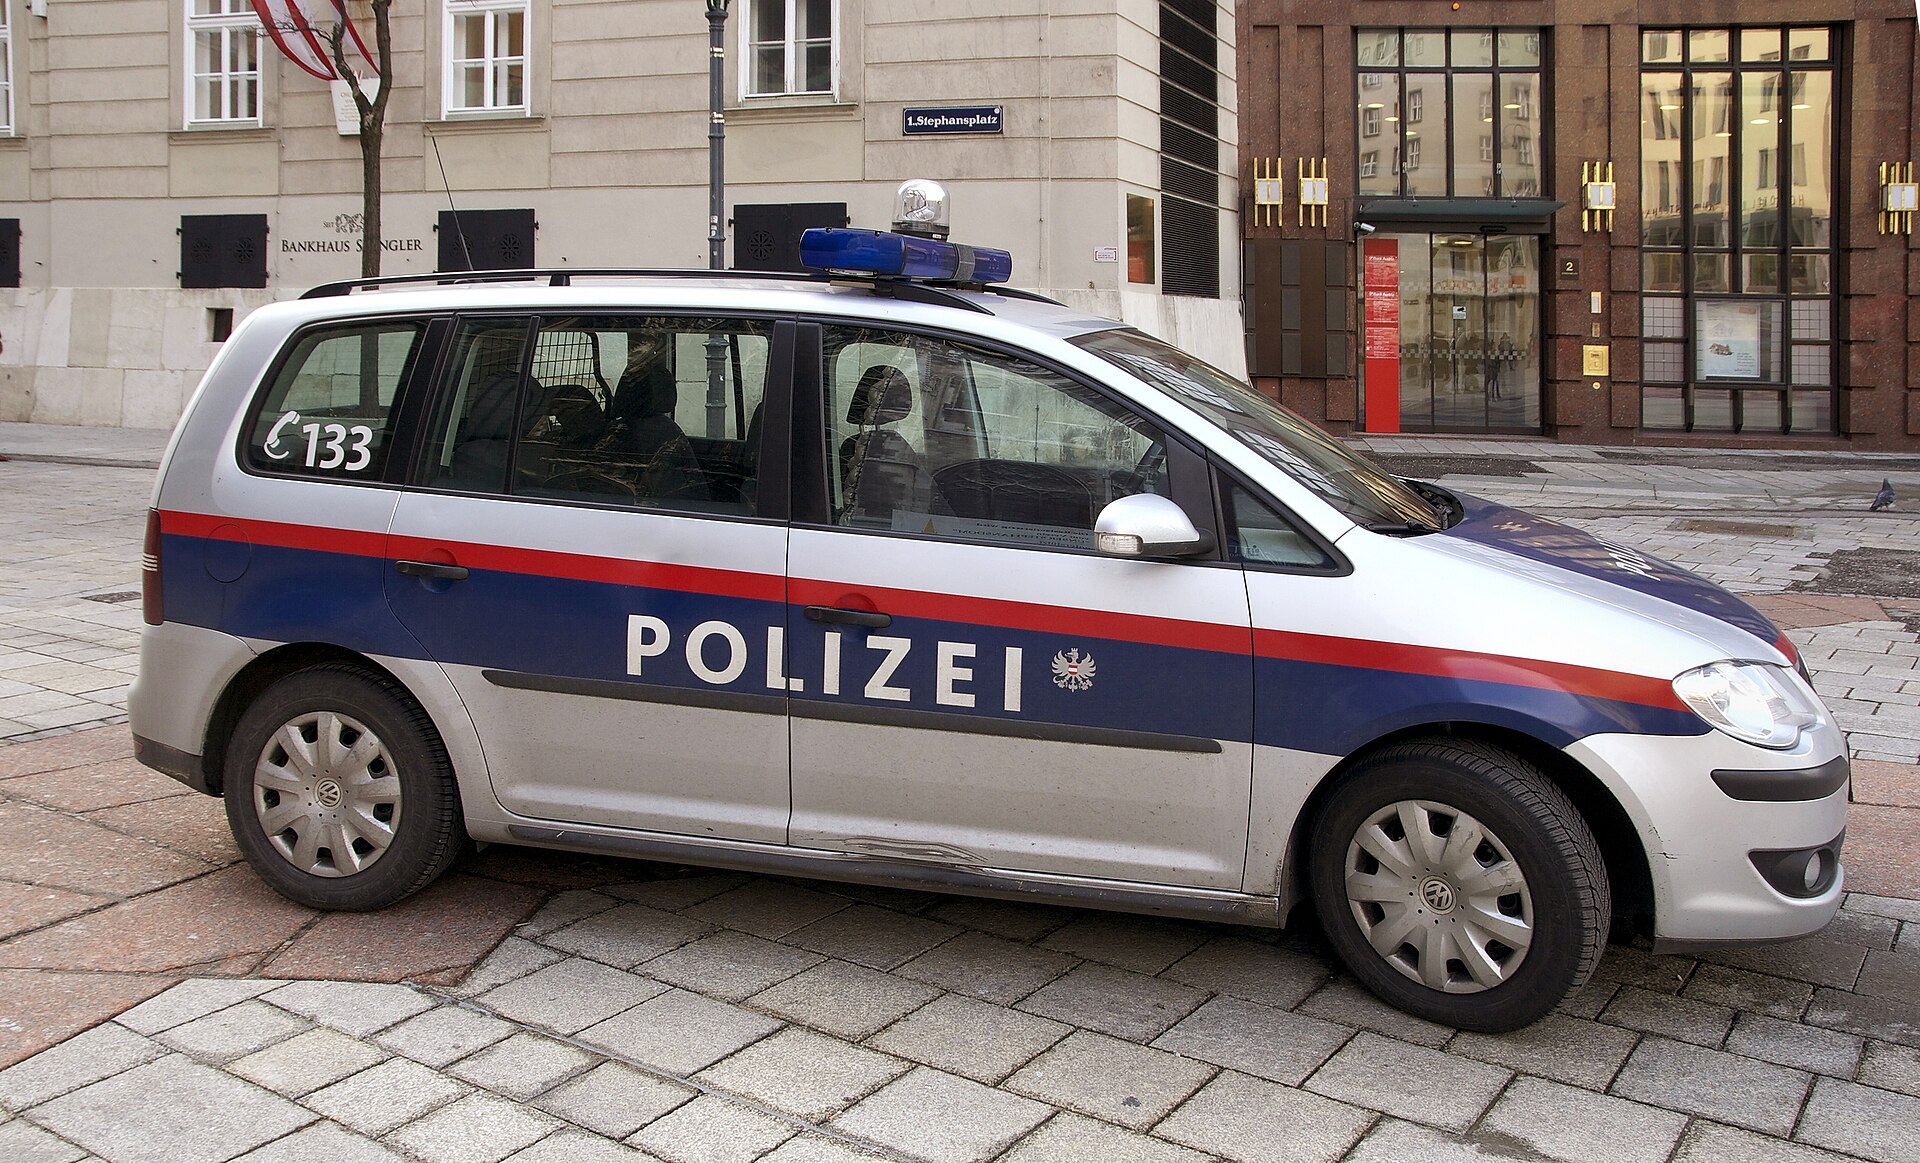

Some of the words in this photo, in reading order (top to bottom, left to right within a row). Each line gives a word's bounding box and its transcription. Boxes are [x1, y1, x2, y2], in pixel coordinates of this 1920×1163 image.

[281, 239, 350, 253] BANKHAUS
[355, 239, 423, 253] SNGLER
[1566, 261, 1574, 272] 2
[302, 423, 373, 471] 133
[626, 614, 1023, 712] POLIZEI
